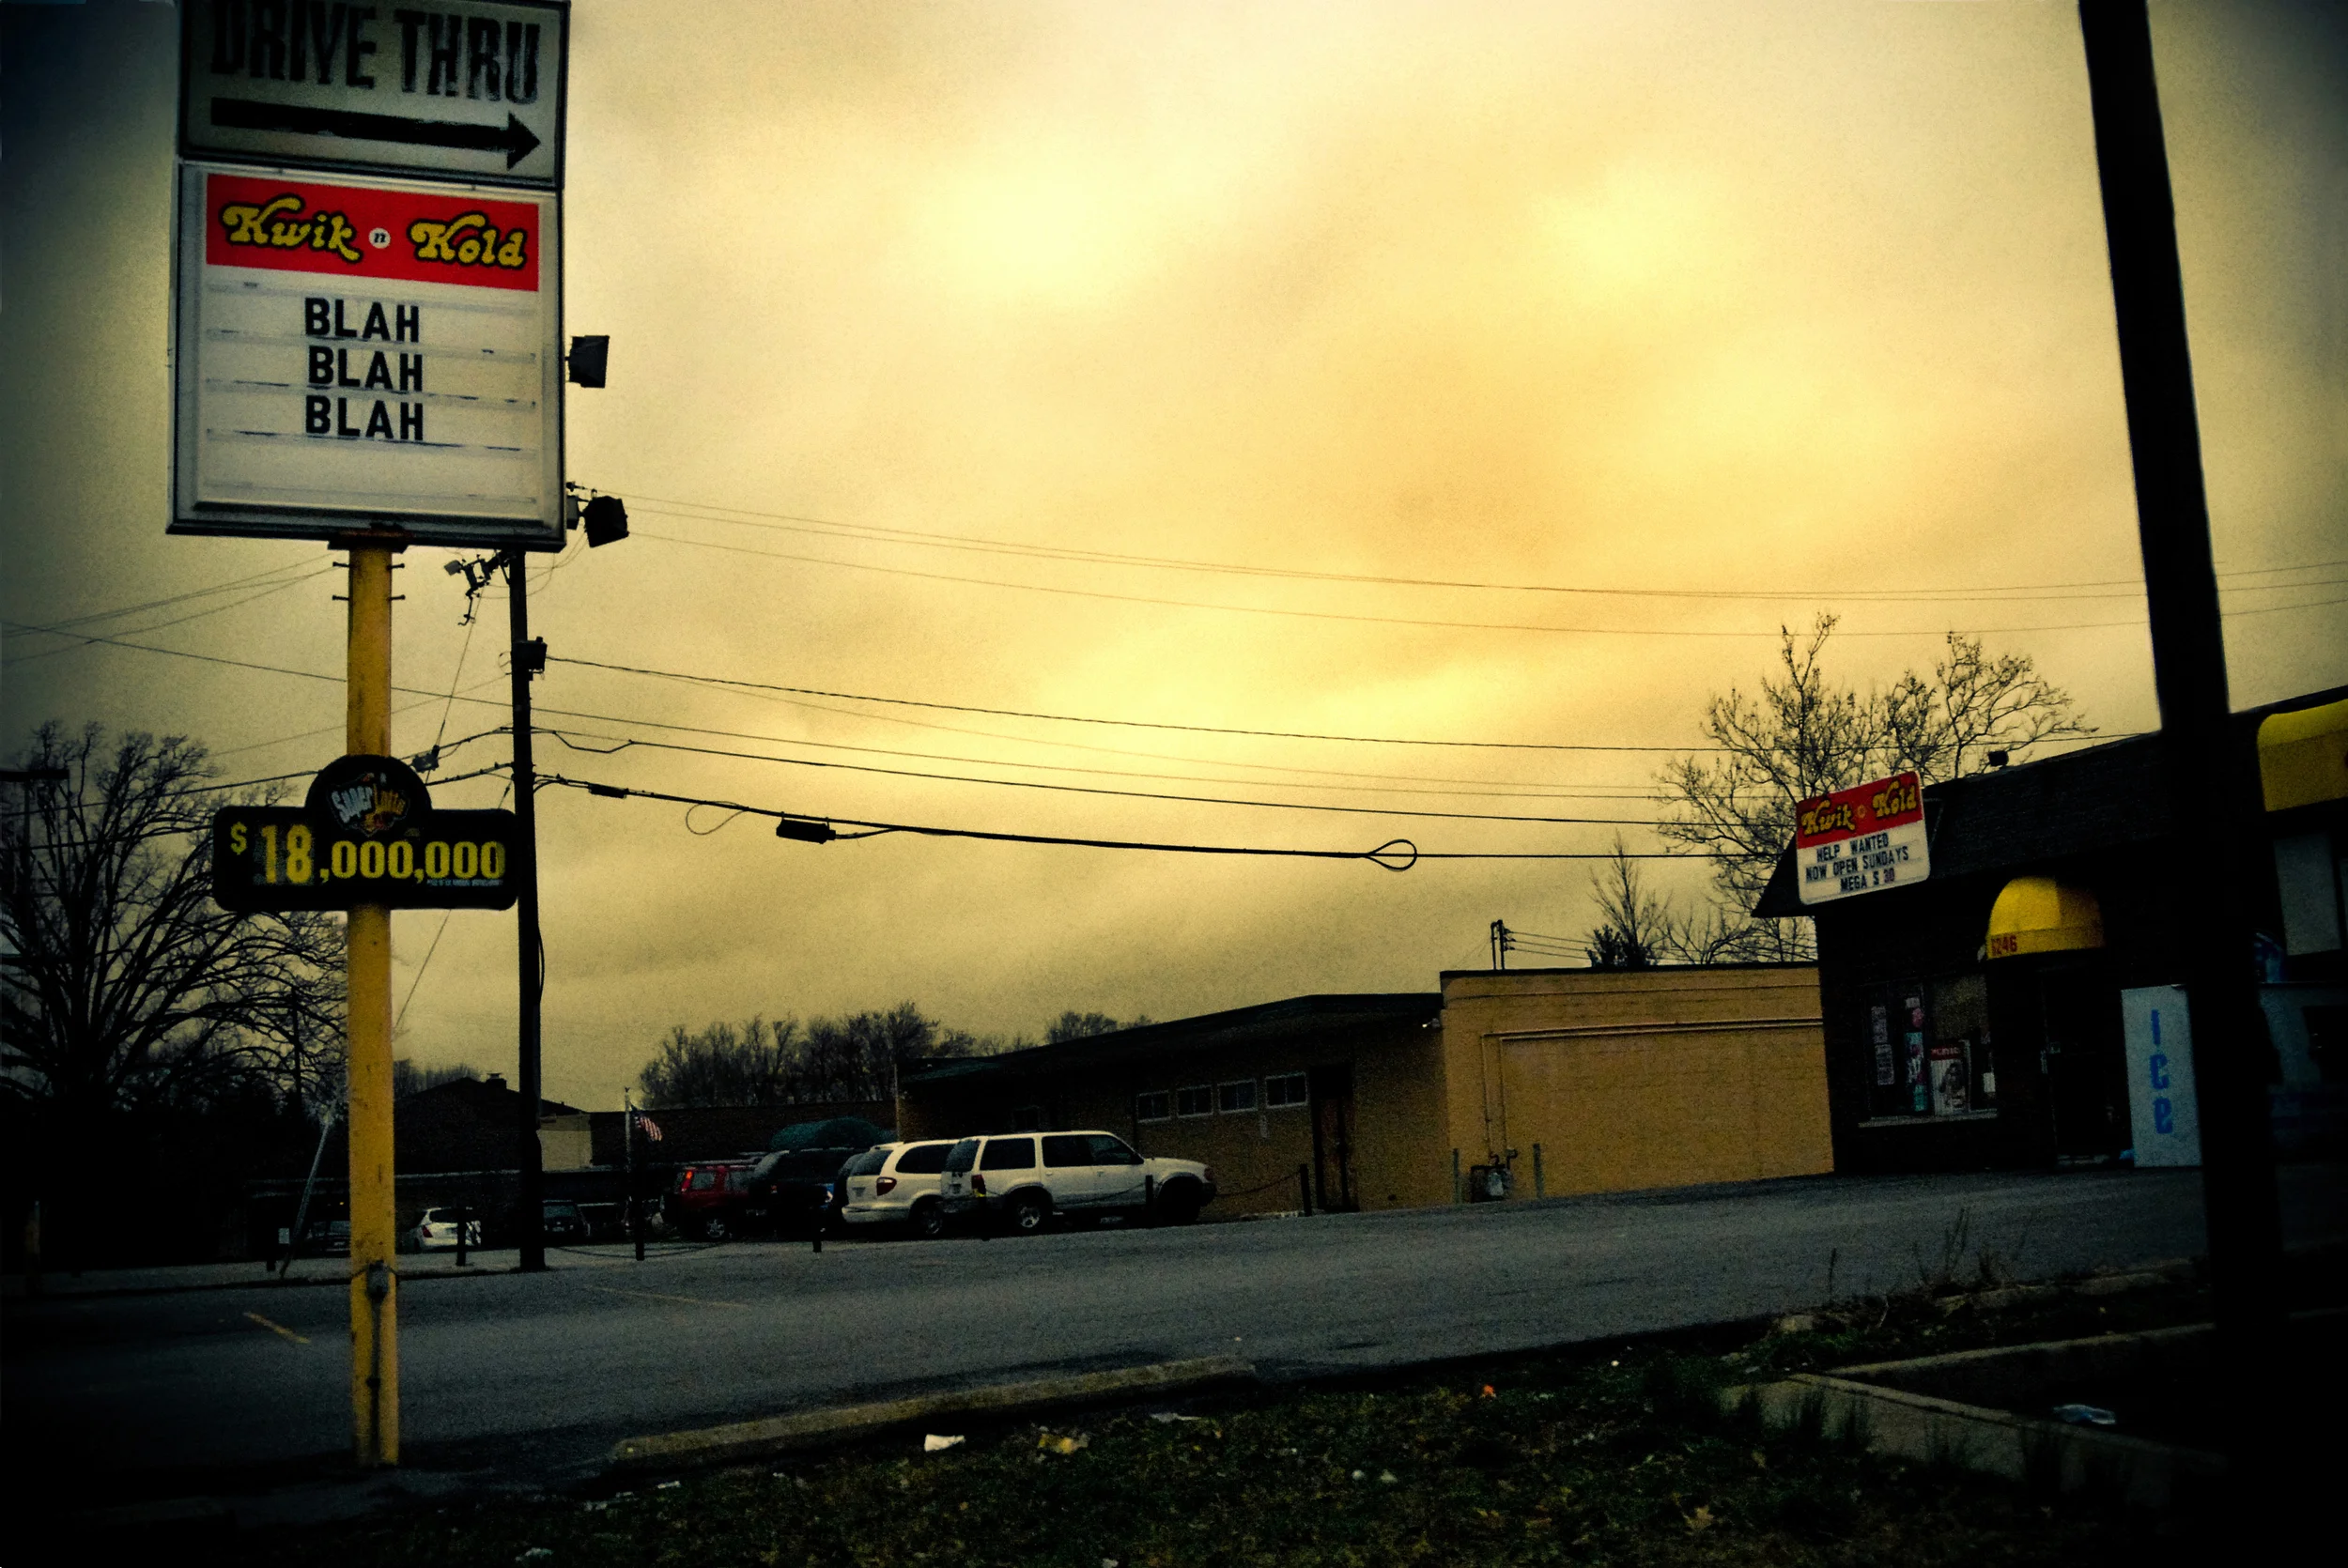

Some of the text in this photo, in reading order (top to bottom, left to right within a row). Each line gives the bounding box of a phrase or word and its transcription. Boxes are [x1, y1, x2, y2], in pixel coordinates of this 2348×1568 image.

[210, 0, 540, 105] DRIVE THRU
[221, 194, 363, 263] Kwik
[409, 212, 527, 269] Kold
[305, 298, 419, 342] BLAH
[309, 346, 423, 391] BLAH
[306, 395, 423, 440] BLAH
[1801, 780, 1917, 836] Kwik Kold
[1806, 846, 1909, 882] NOW OPEN SUNDAYS
[1816, 833, 1890, 863] HELP WANTED
[1840, 875, 1867, 893] MEGA
